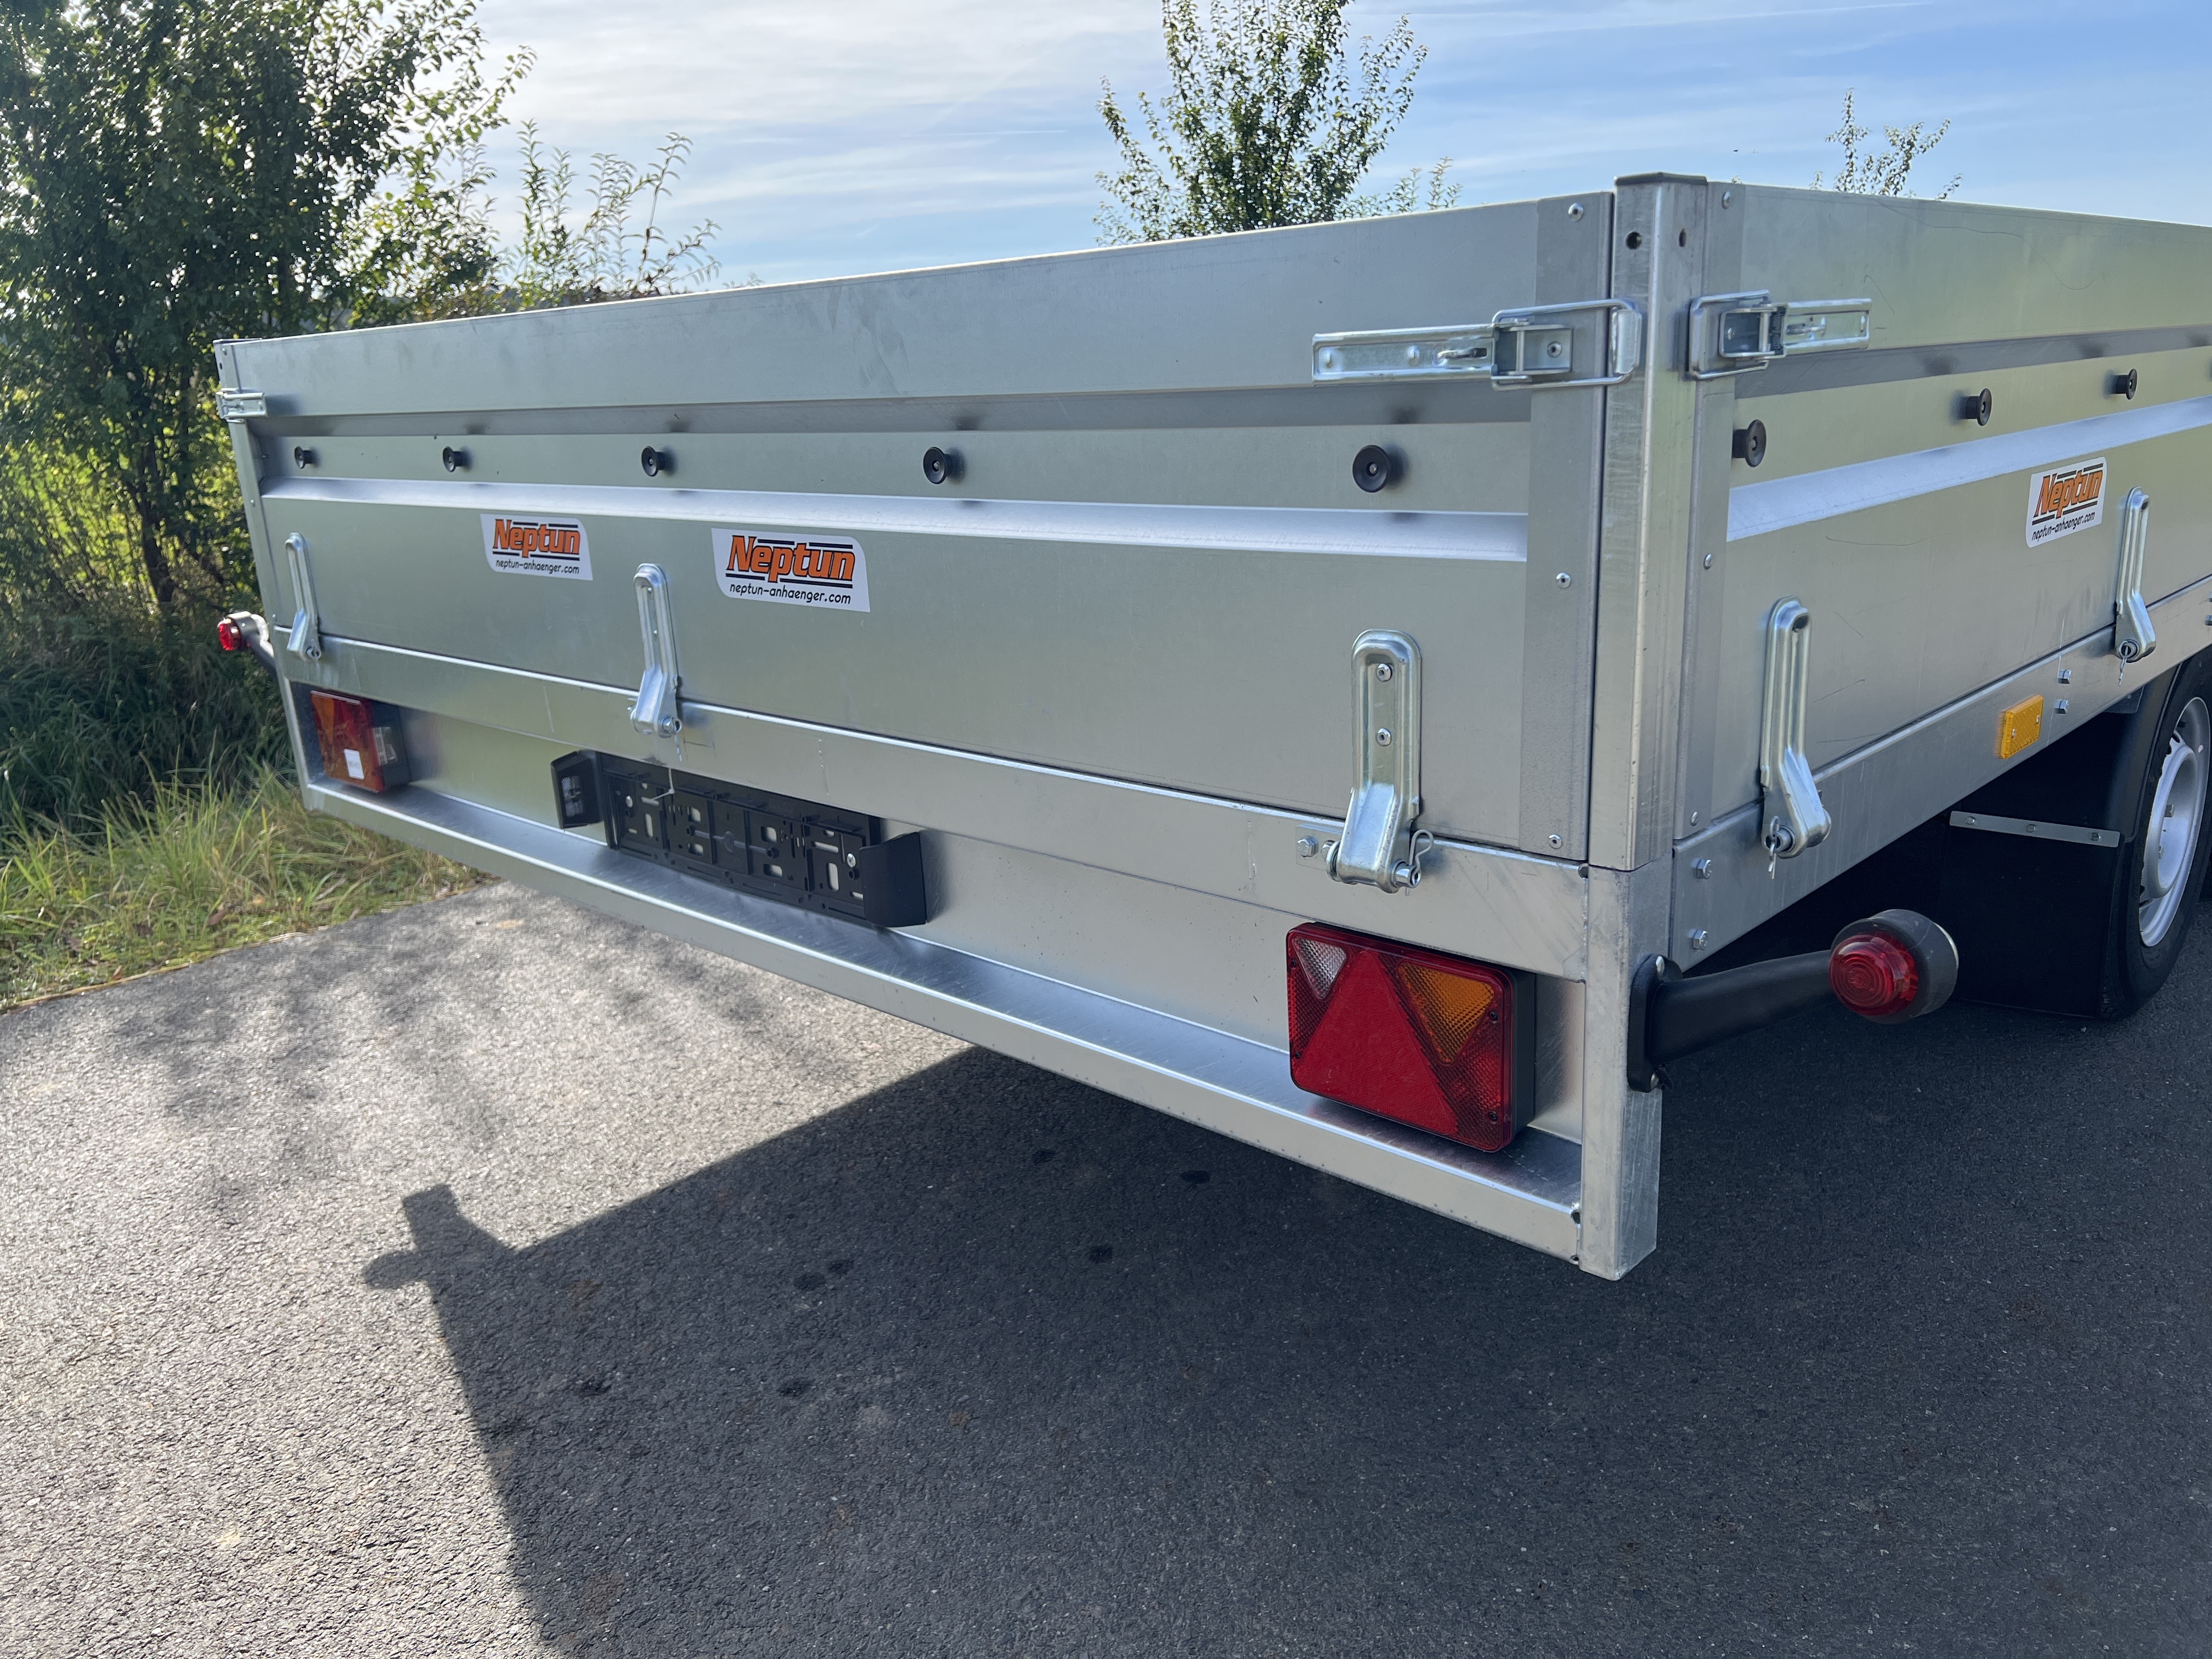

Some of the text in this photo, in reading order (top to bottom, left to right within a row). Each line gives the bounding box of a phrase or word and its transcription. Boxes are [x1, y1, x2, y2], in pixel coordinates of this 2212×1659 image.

[2033, 470, 2103, 519] Neptun
[493, 518, 580, 558] Neptun
[2032, 512, 2095, 541] neptun-anhaenger.com
[496, 558, 579, 574] neptun-anhaenger.com
[726, 535, 855, 583] Neptun
[730, 583, 850, 604] neptun-anhaenger.com
